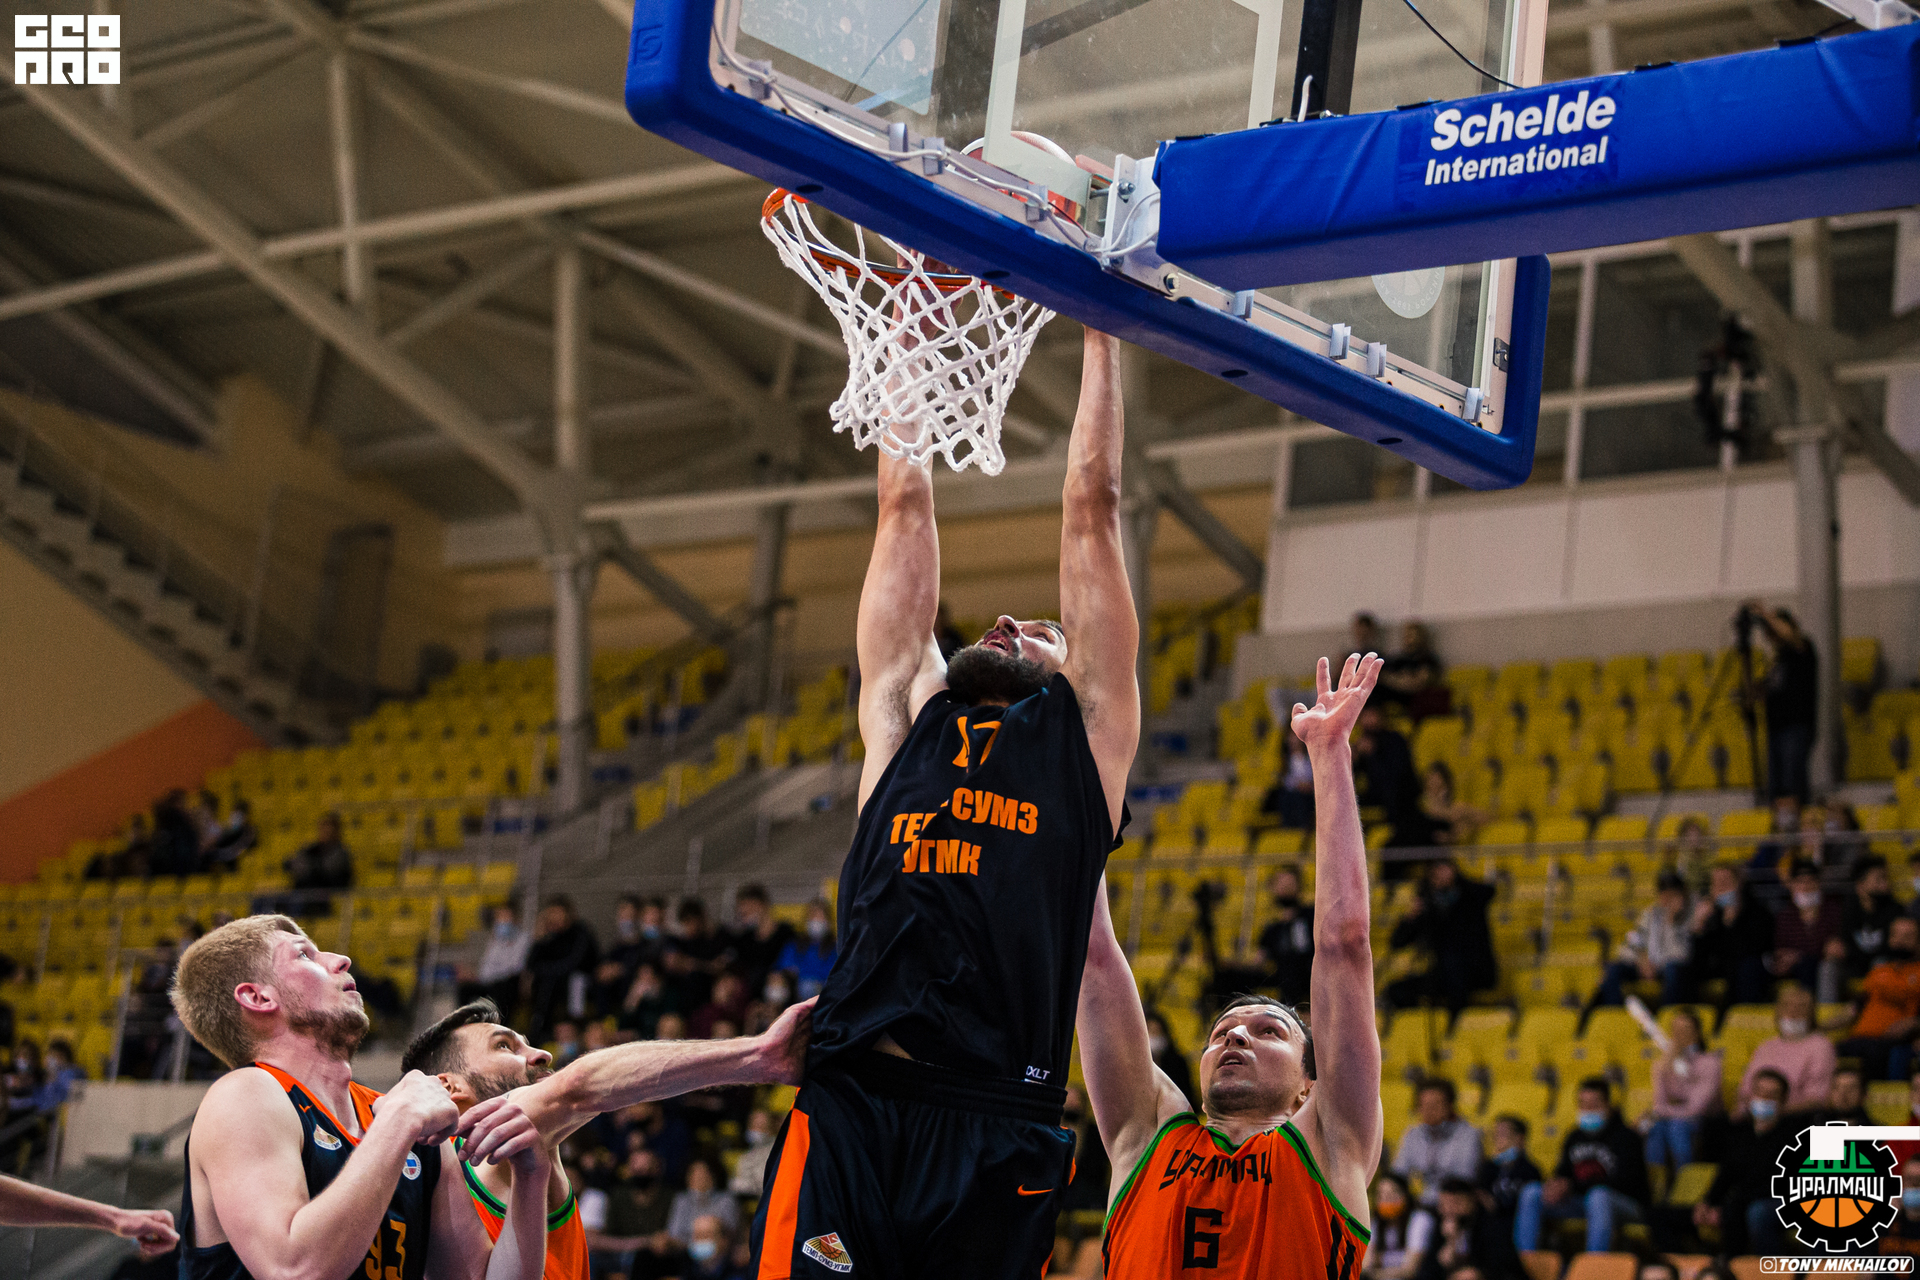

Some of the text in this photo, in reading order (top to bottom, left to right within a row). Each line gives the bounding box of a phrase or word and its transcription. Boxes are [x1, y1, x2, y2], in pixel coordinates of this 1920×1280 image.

[1430, 90, 1616, 151] Schelde
[1424, 135, 1609, 185] International
[1182, 1205, 1224, 1270] 6
